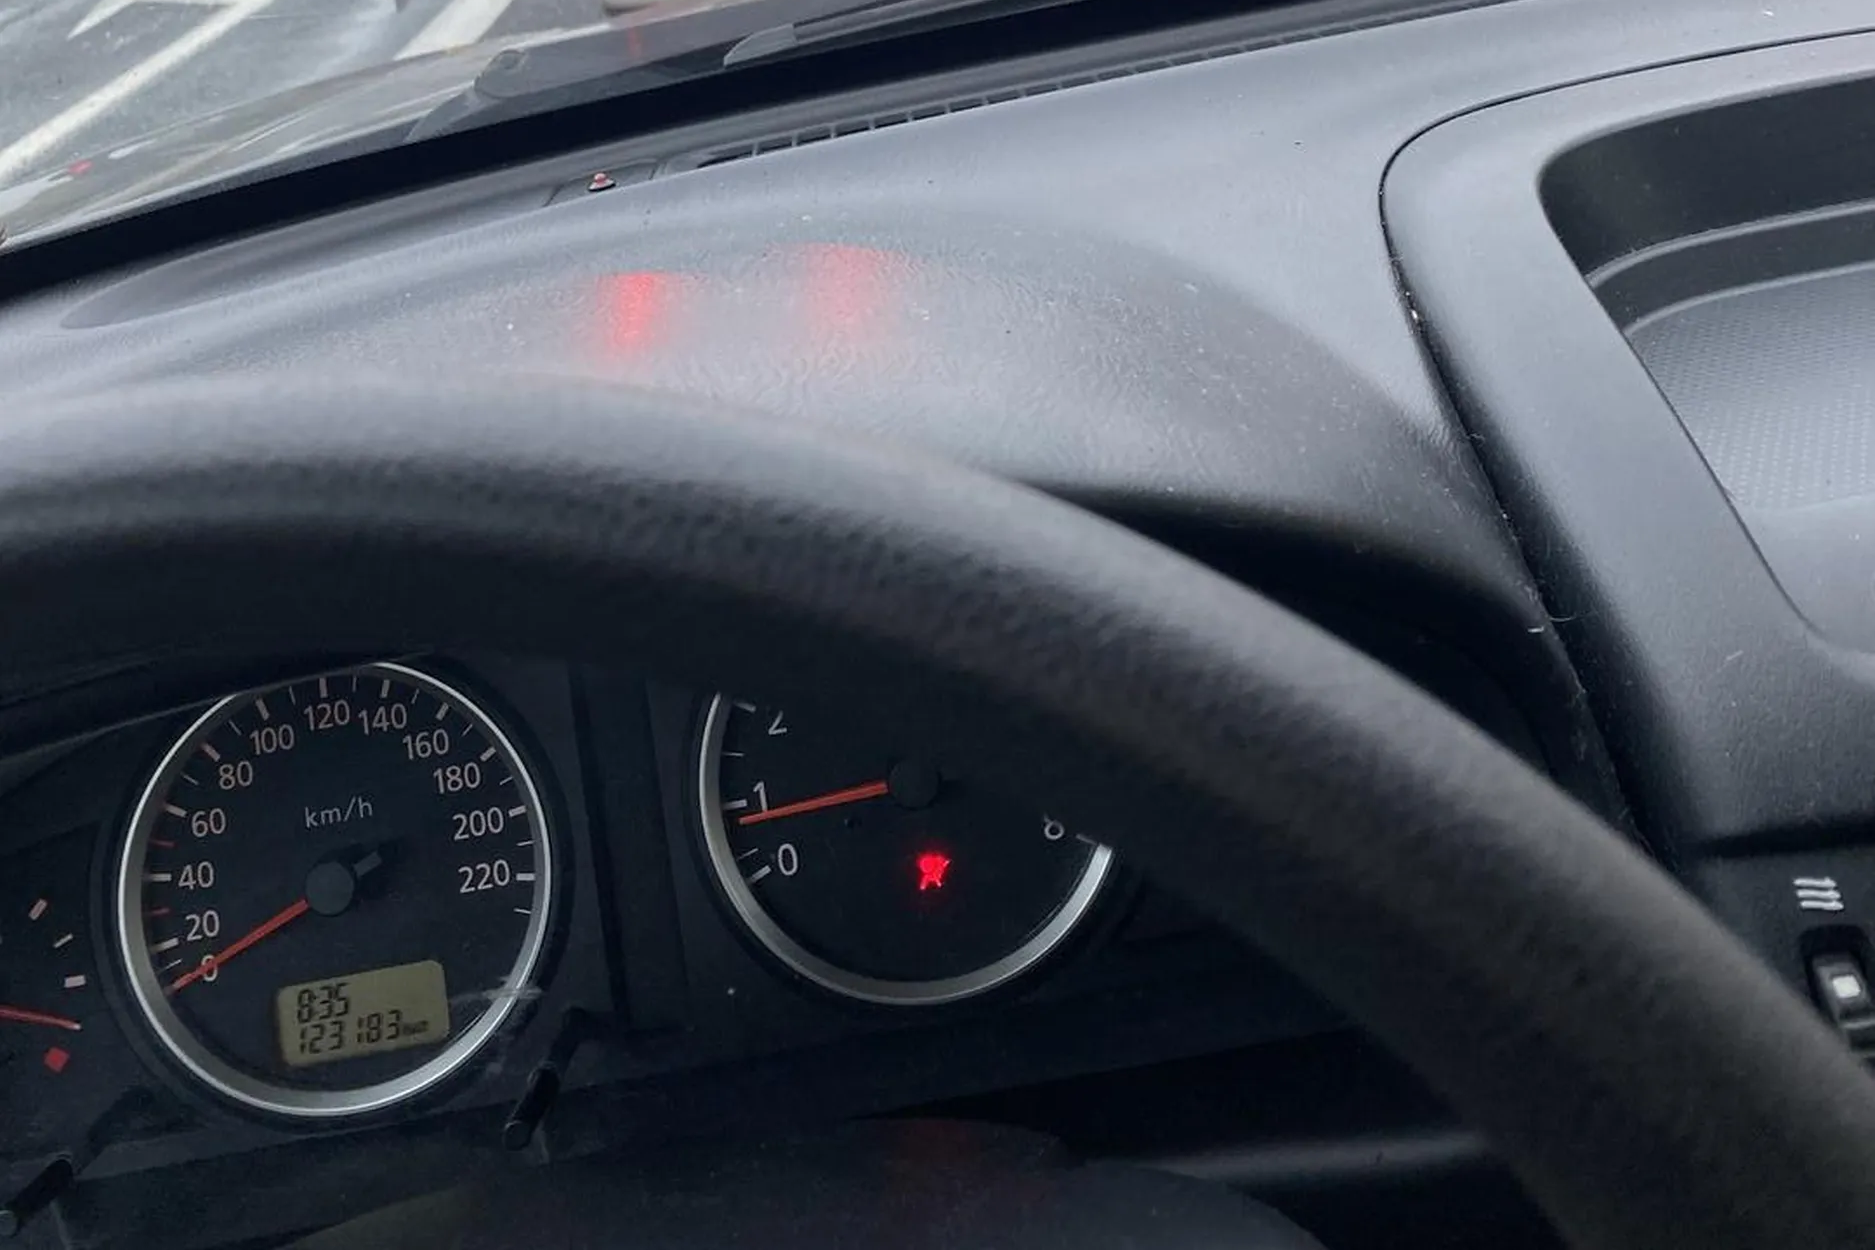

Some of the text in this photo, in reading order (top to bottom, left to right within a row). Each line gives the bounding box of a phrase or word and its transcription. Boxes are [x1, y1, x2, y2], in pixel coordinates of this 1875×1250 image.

[302, 698, 351, 732] 120
[358, 702, 408, 736] 140
[249, 724, 296, 756] 100
[402, 728, 450, 761] 160
[218, 760, 254, 790] 80
[433, 761, 481, 795] 180
[304, 795, 374, 829] km/h
[753, 781, 768, 813] 1
[191, 807, 227, 838] 60
[452, 806, 505, 841] 200
[178, 860, 215, 890] 40
[458, 858, 511, 894] 220
[777, 843, 799, 876] 0
[185, 909, 220, 941] 20
[200, 954, 219, 982] 0
